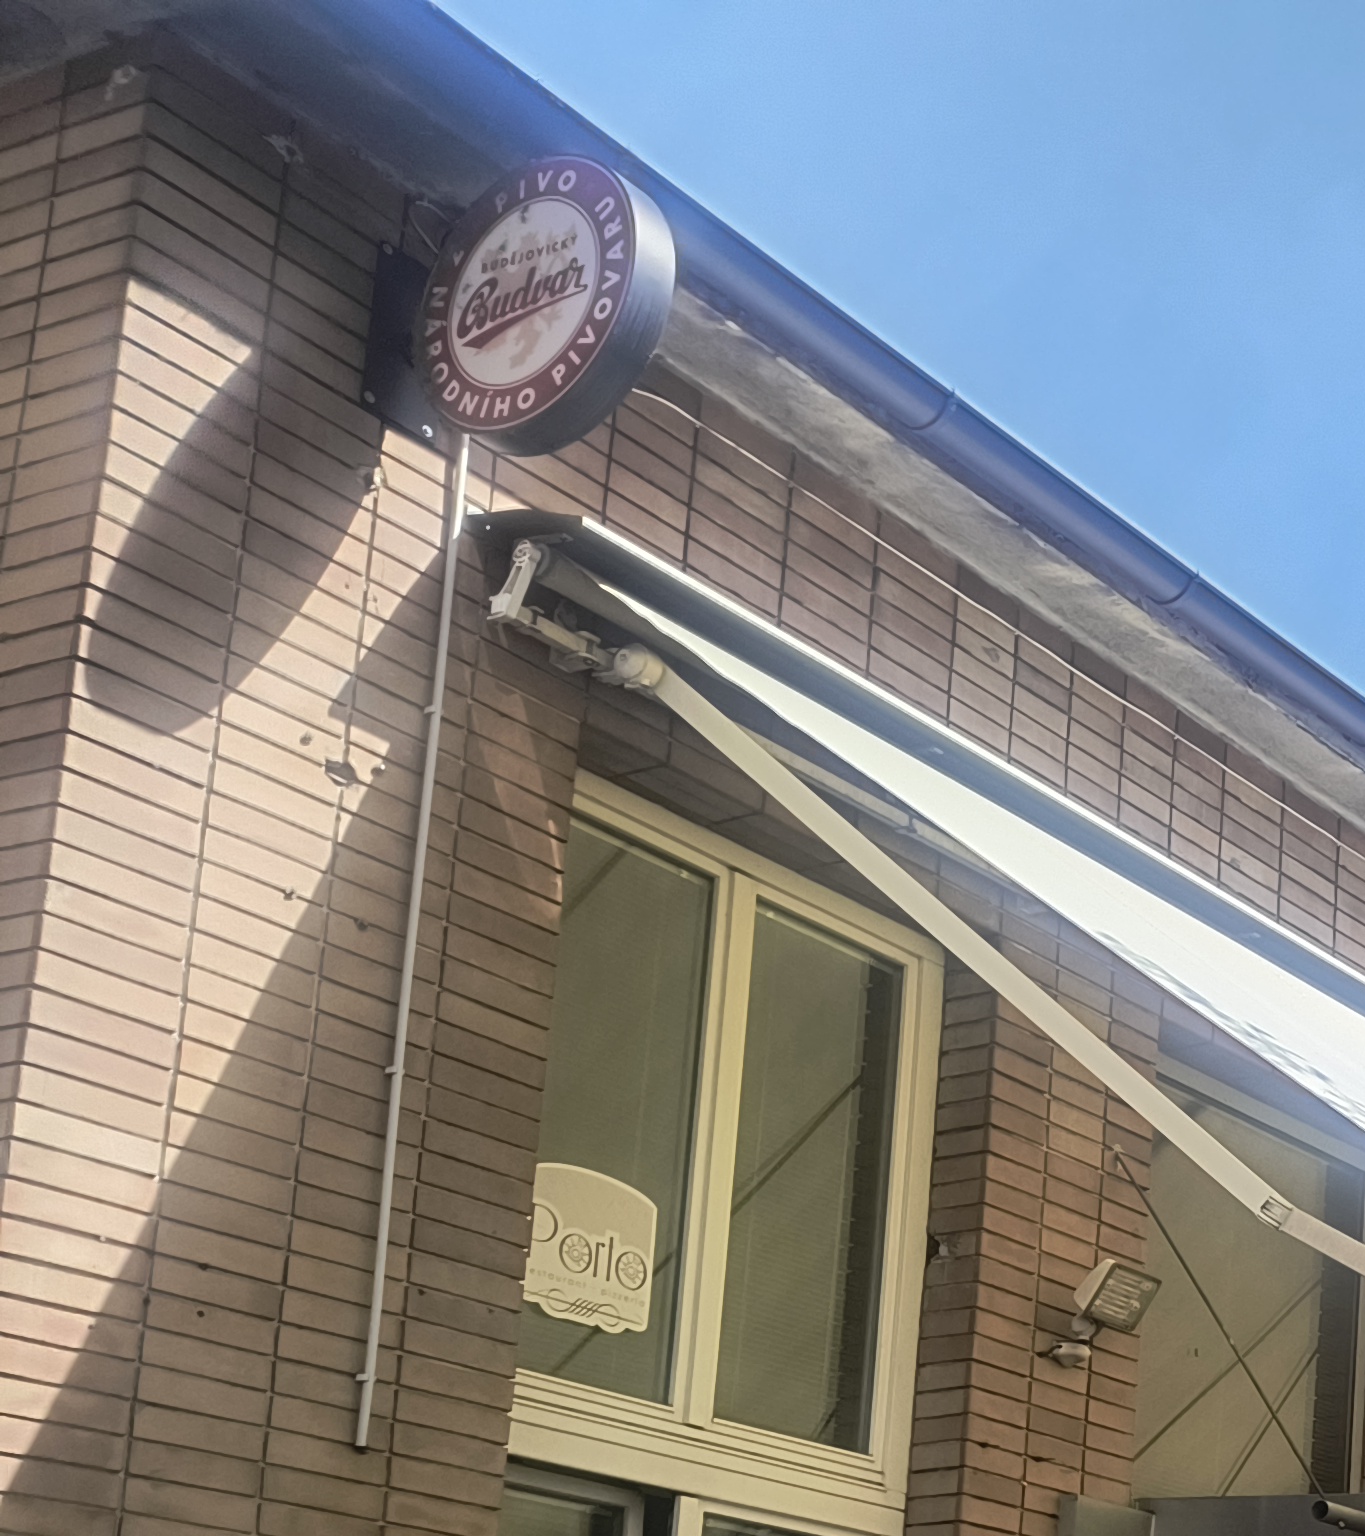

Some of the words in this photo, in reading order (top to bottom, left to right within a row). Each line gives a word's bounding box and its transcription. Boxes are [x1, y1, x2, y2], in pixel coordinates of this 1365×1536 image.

[456, 257, 589, 344] Budvar
[495, 168, 578, 215] PIVO
[551, 195, 626, 387] PIVOVARU
[528, 1266, 588, 1289] estaurant
